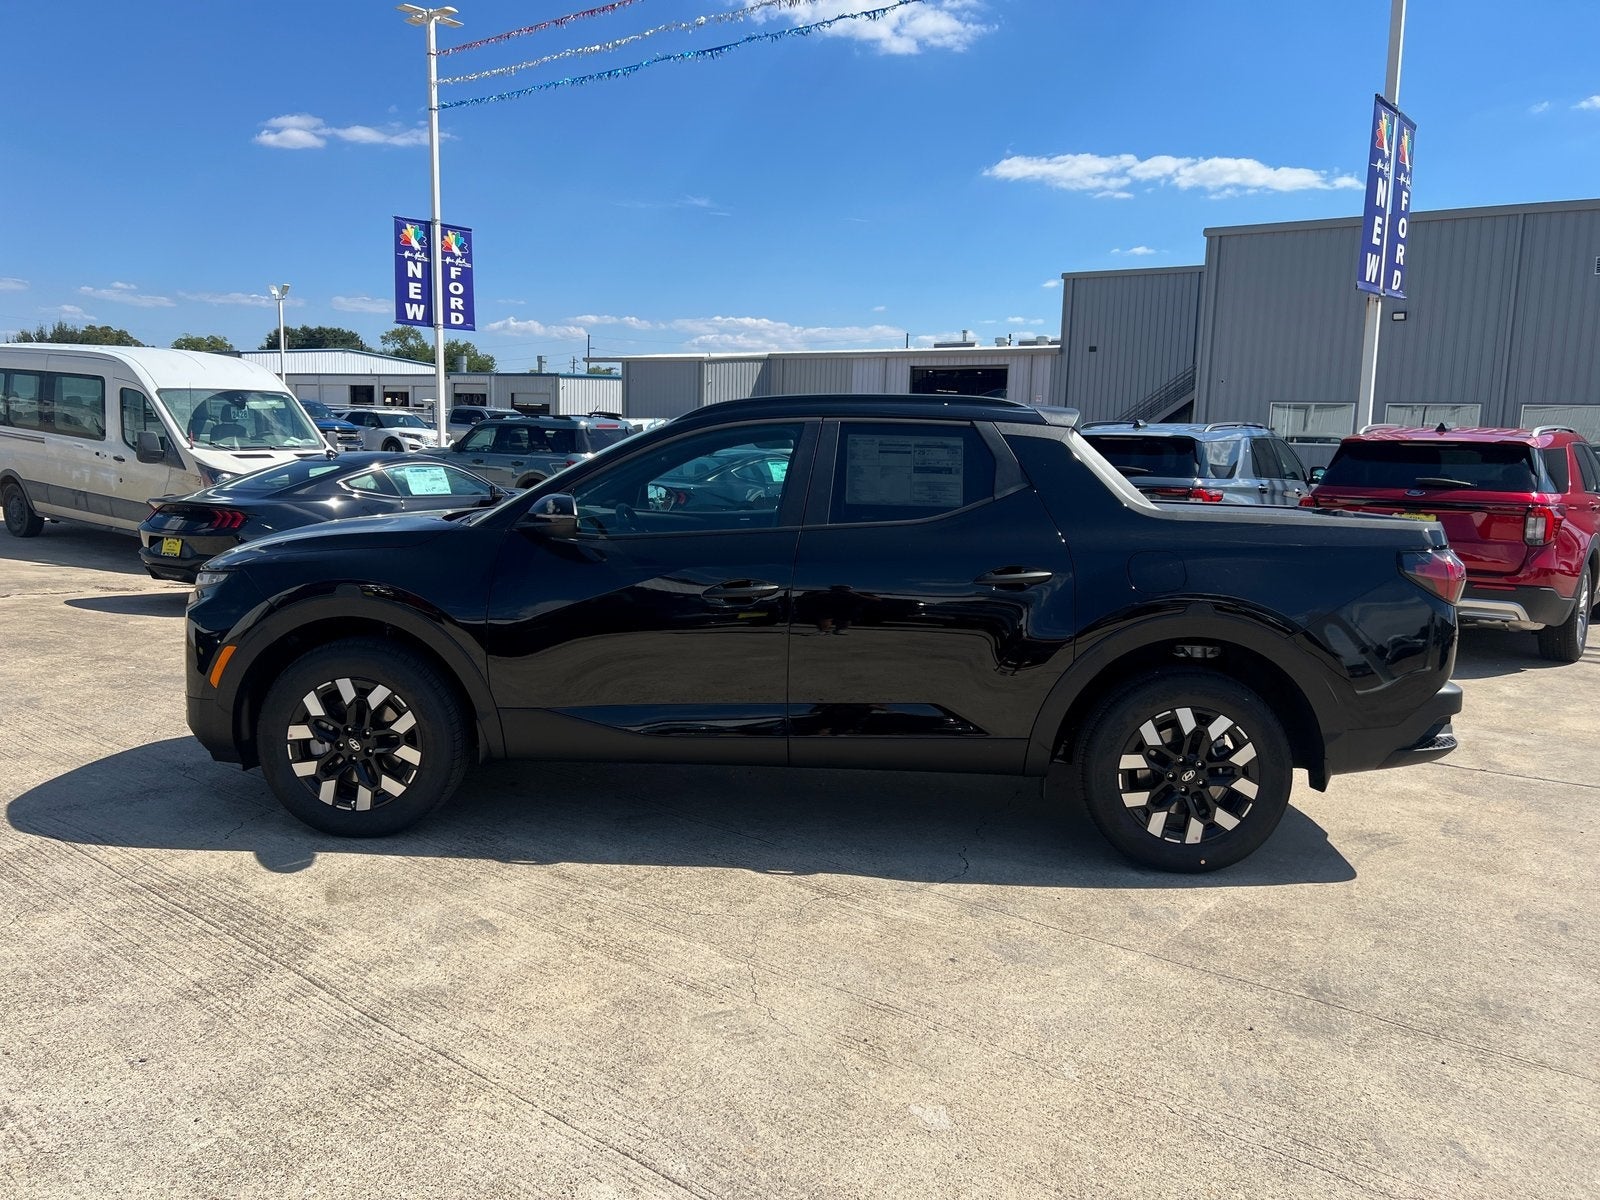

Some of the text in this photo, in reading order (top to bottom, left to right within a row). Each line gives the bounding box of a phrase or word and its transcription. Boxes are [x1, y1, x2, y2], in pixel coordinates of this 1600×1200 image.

[1365, 178, 1387, 283] NEW
[1392, 191, 1409, 291] FORD
[405, 261, 425, 320] NEW
[449, 267, 464, 324] FORD
